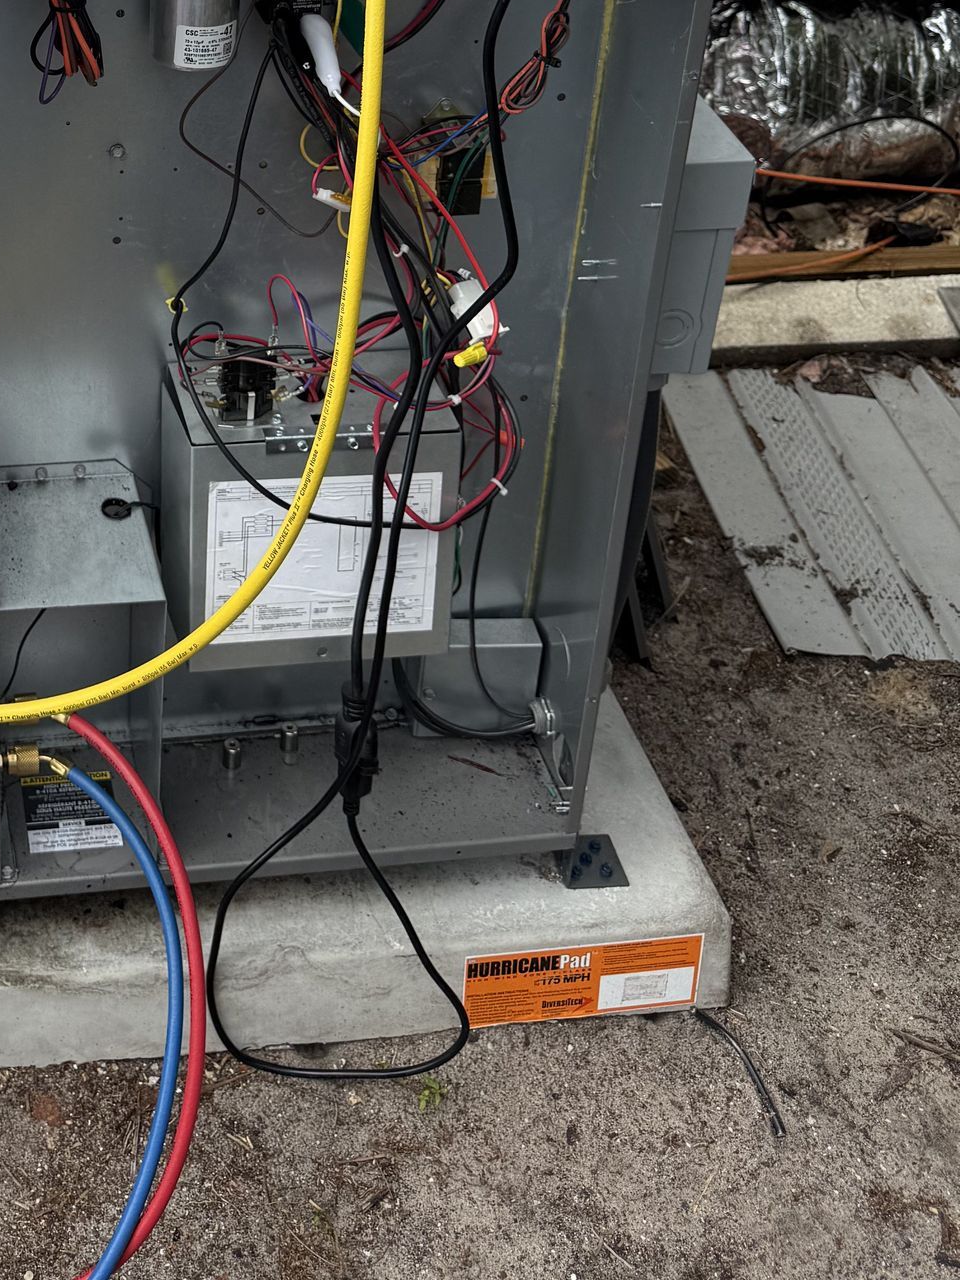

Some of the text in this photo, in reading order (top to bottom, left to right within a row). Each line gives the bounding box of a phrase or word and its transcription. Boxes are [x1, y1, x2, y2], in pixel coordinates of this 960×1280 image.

[185, 29, 199, 37] CSC
[262, 547, 279, 571] YELLOW
[288, 510, 297, 526] Plus
[299, 467, 314, 496] Charging
[309, 449, 319, 467] Hose
[11, 711, 40, 721] Charging
[40, 709, 56, 717] Hose
[30, 775, 65, 783] ATTENTIO
[542, 972, 591, 986] 175 MPH
